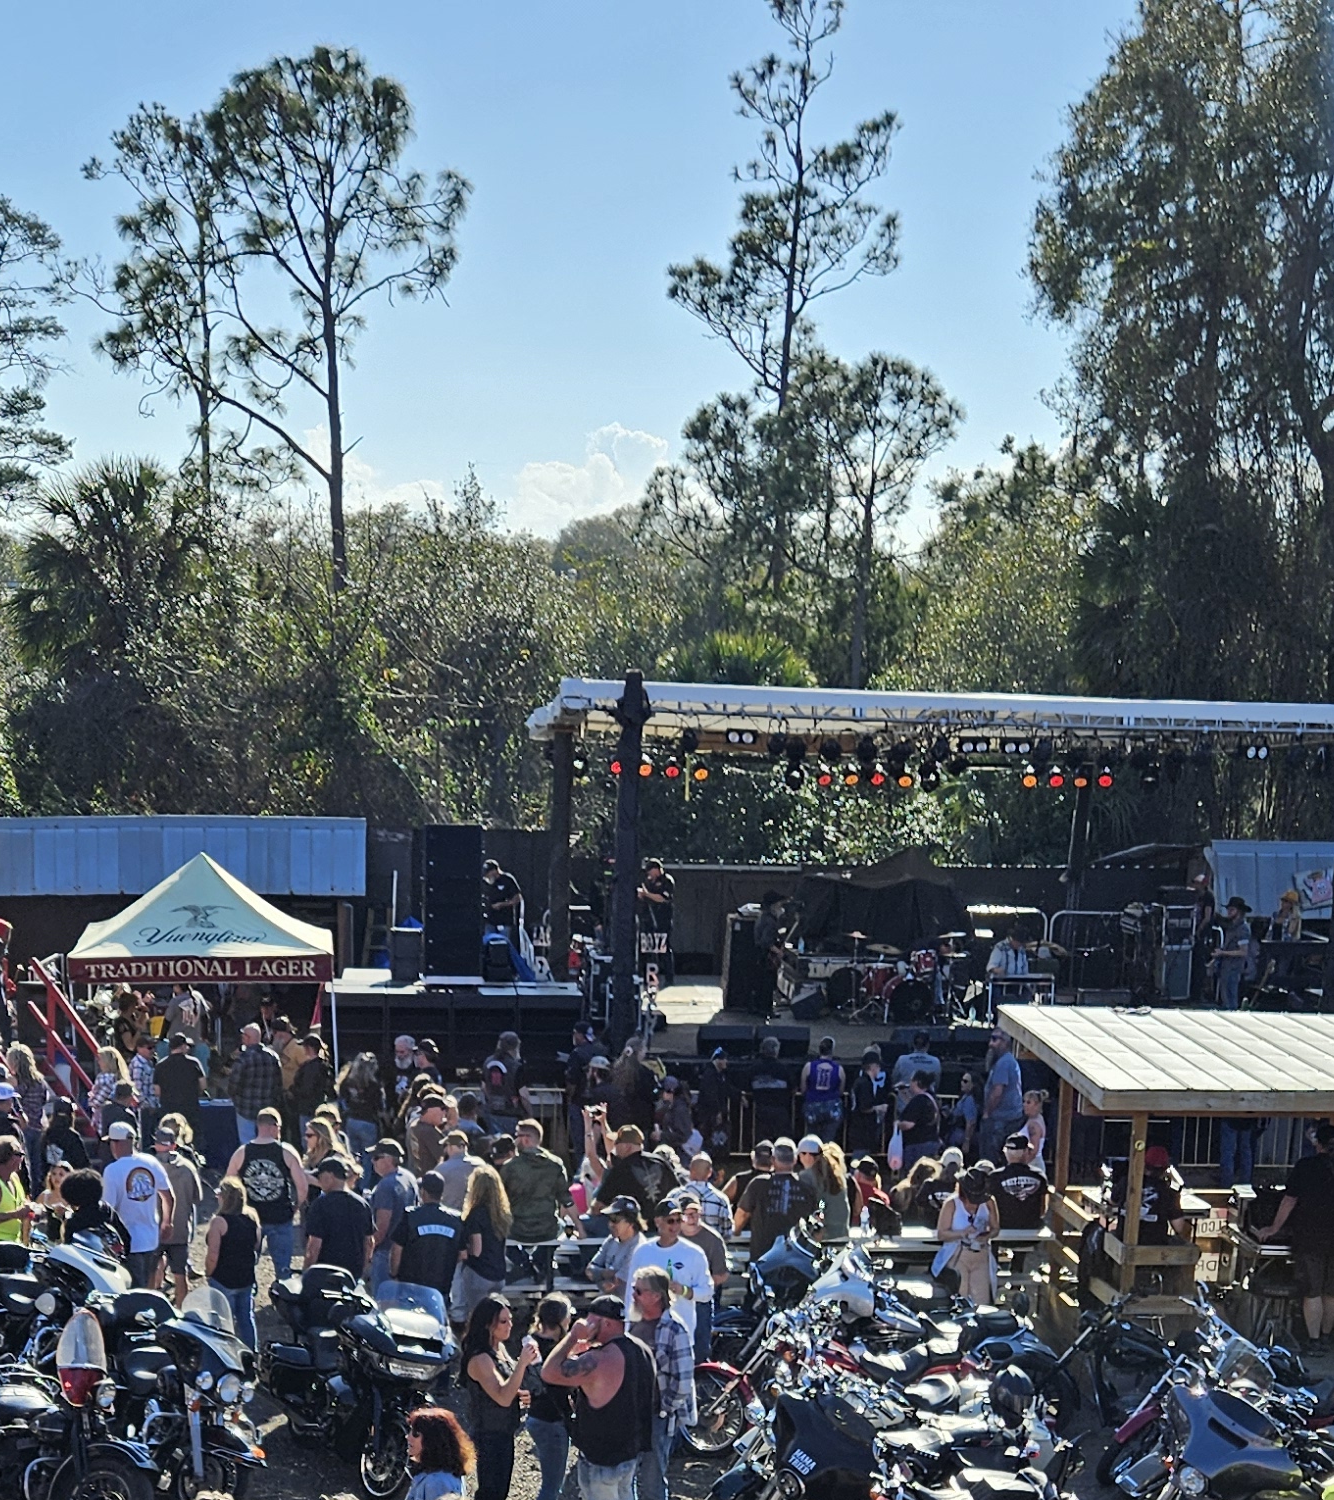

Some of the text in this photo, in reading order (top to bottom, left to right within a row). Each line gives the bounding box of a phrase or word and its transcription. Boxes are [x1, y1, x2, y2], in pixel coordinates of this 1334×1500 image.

[133, 926, 268, 947] Yuengling
[85, 959, 317, 979] TRADITIONAL LAGER
